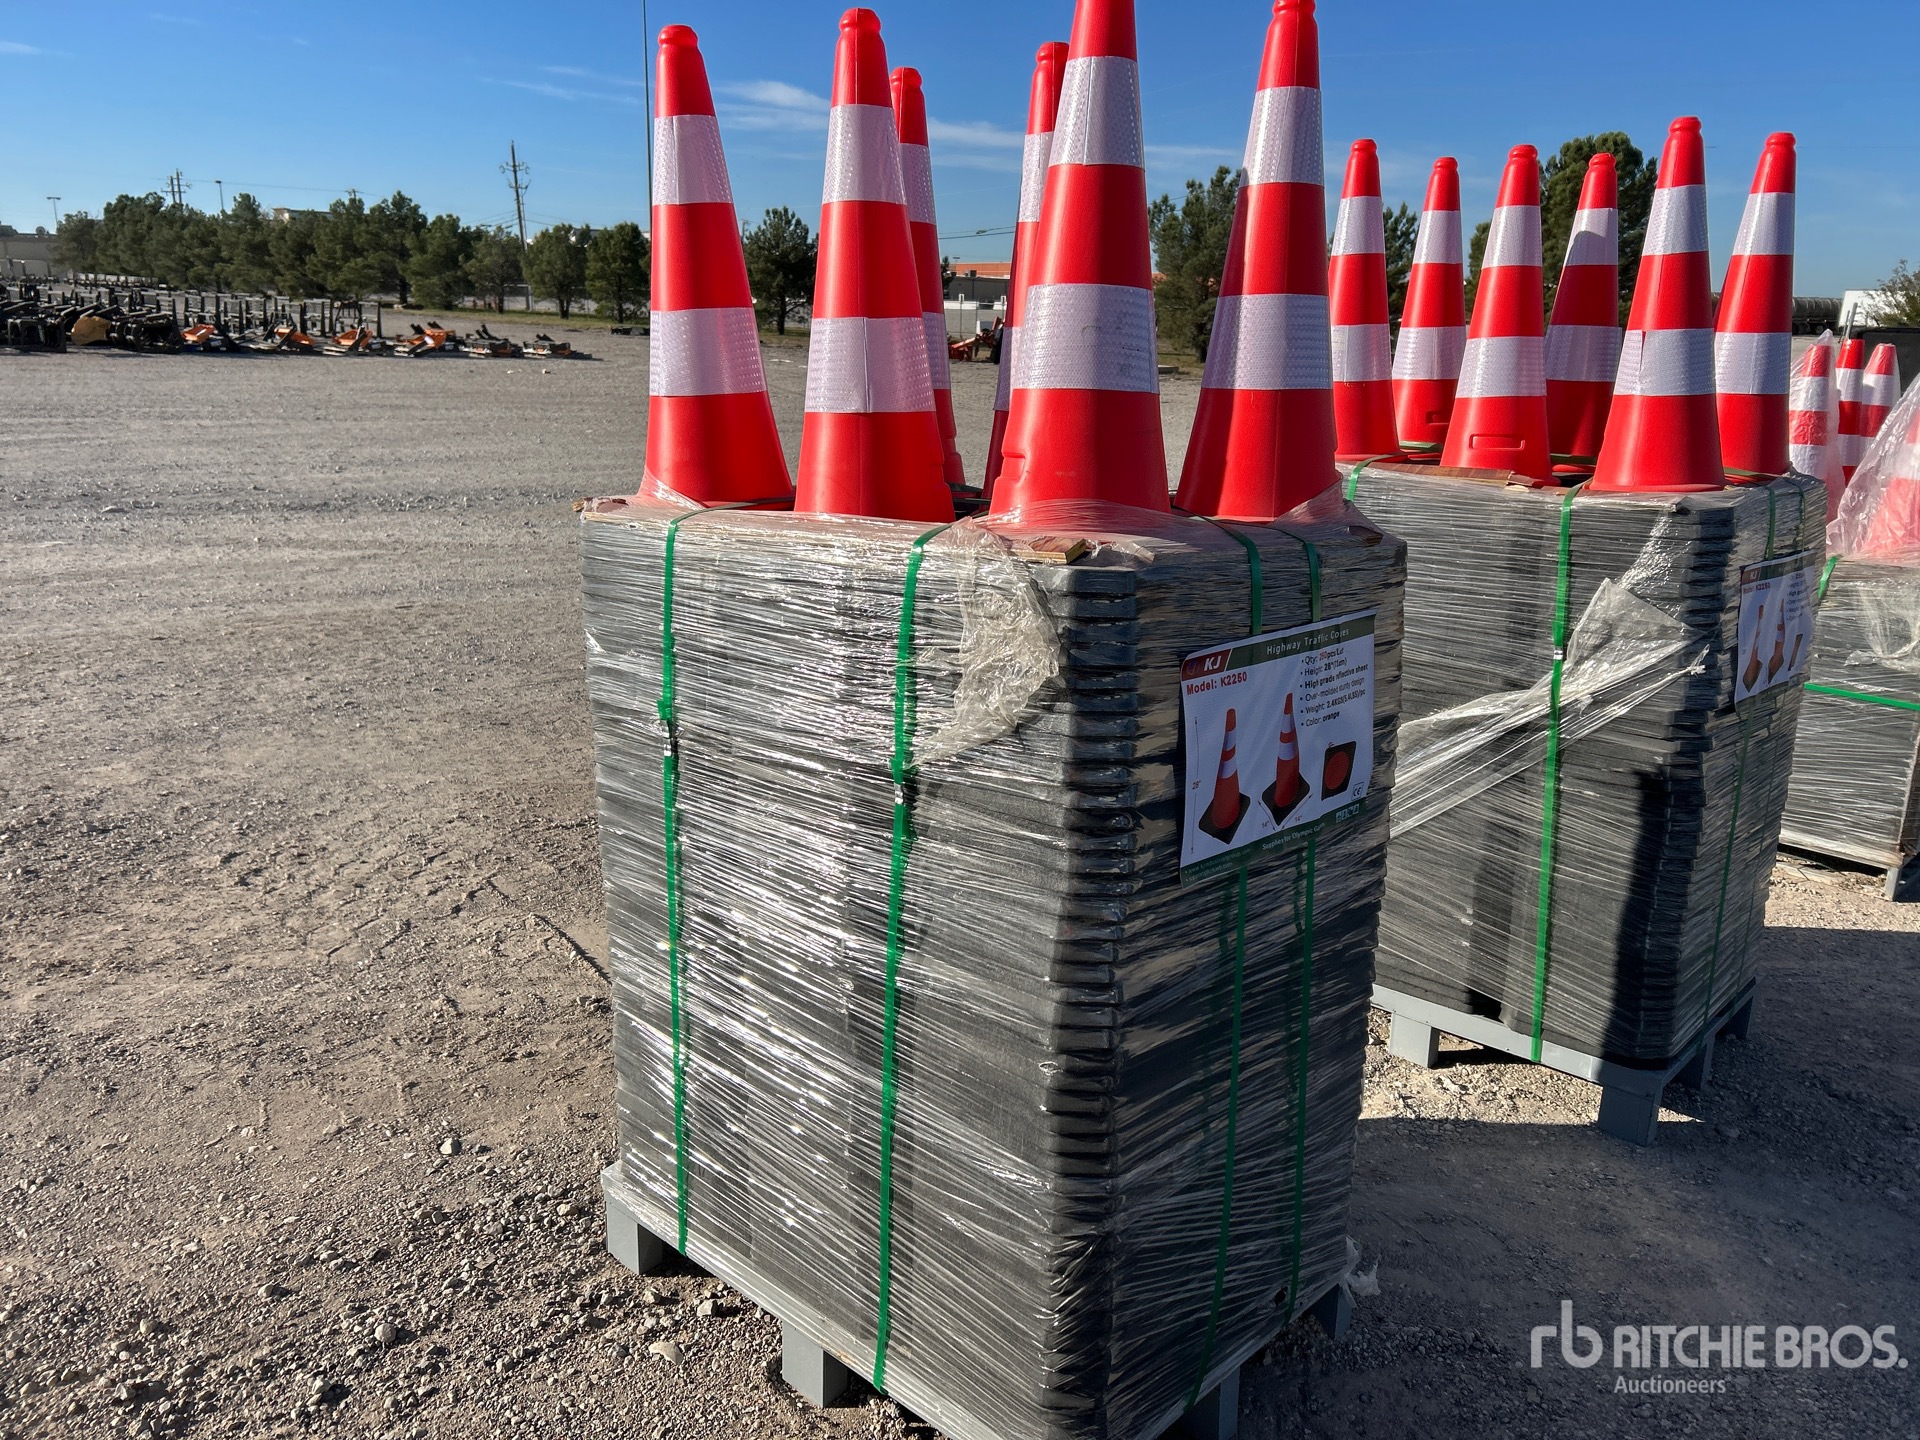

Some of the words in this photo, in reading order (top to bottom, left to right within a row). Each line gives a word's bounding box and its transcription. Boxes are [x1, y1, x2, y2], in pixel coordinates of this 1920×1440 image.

[1266, 641, 1301, 655] Highway
[1304, 633, 1329, 646] Traffic
[1203, 656, 1222, 671] KJ
[1186, 679, 1217, 695] Model:
[1220, 671, 1248, 687] K2250
[1304, 680, 1319, 689] High
[1320, 675, 1335, 687] grade
[1322, 711, 1340, 722] orange
